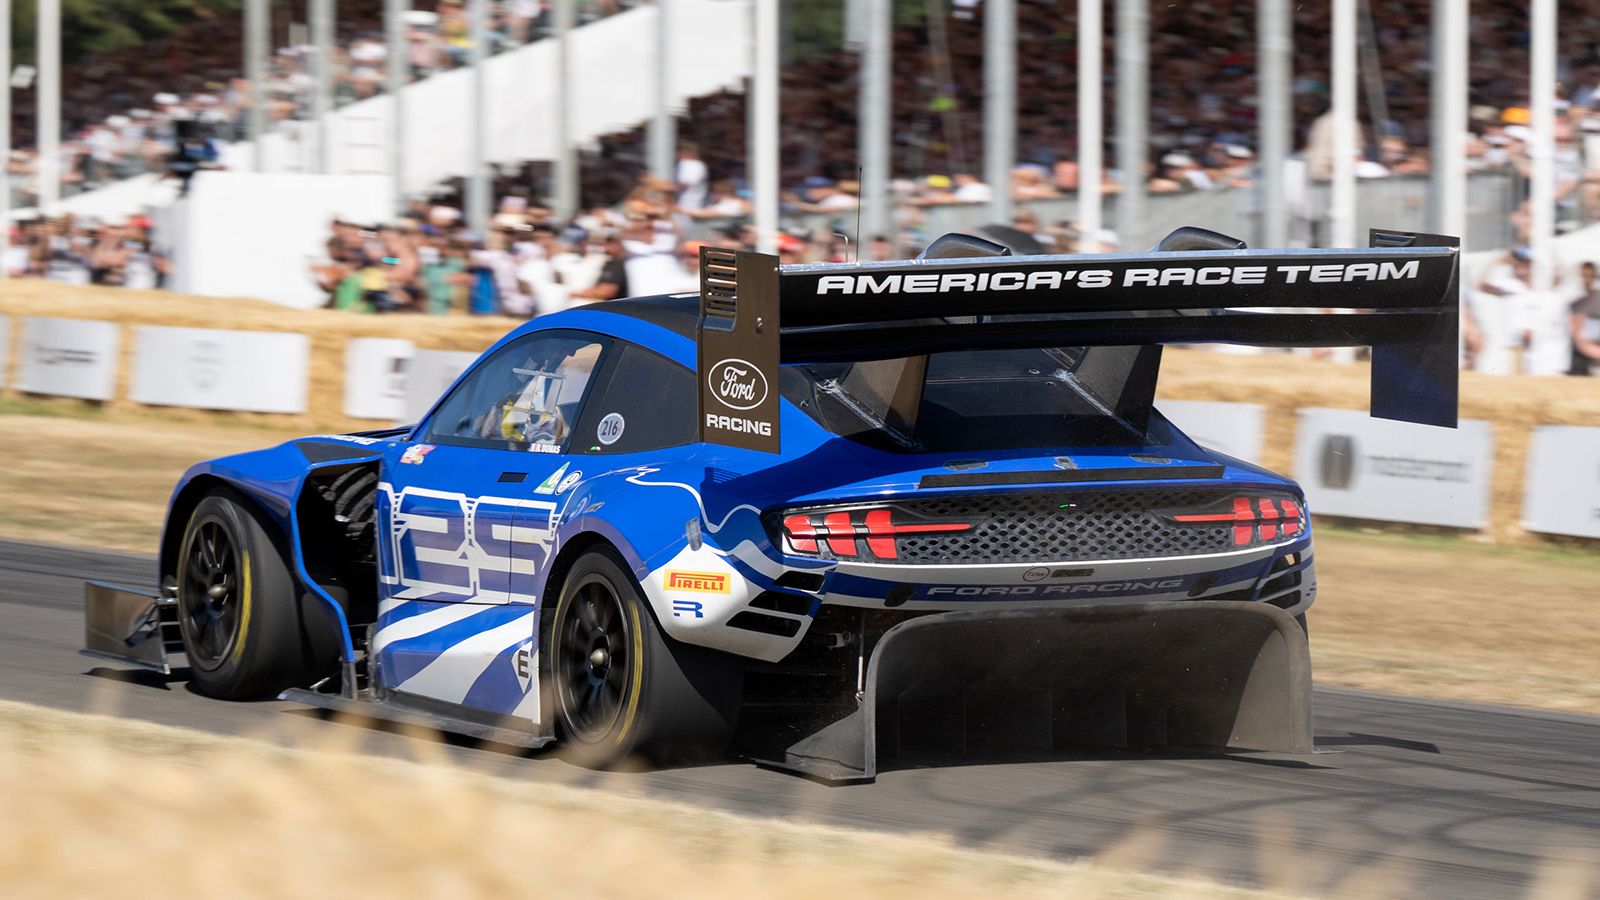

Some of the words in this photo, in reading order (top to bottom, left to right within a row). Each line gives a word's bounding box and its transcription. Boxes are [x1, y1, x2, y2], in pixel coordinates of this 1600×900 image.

[816, 268, 1113, 295] AMERICA'S
[1123, 265, 1268, 288] RACE
[1276, 260, 1419, 284] TEAM
[720, 366, 756, 401] Ford
[601, 421, 618, 436] 216
[706, 413, 772, 436] RACING
[670, 573, 725, 591] PIRELLI
[927, 586, 1037, 595] FORD
[1044, 579, 1182, 594] RACING
[518, 650, 529, 679] E
